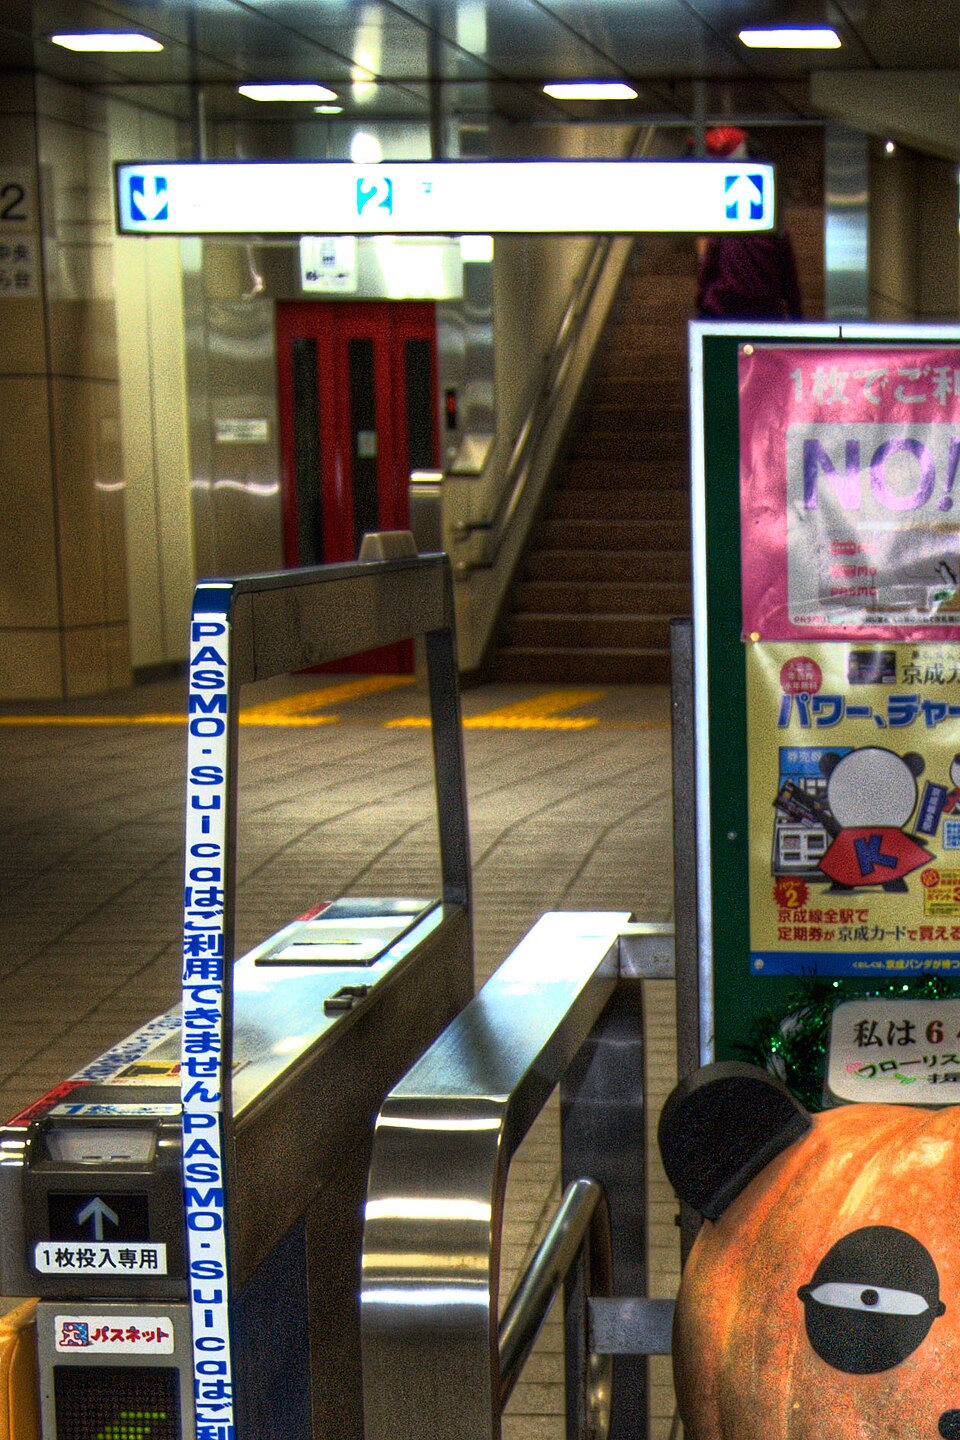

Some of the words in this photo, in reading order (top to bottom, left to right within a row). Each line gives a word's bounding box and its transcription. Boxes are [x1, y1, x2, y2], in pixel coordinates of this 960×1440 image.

[0, 184, 27, 220] 2
[360, 178, 391, 216] 2
[854, 834, 898, 877] K
[786, 889, 799, 908] 2
[777, 909, 869, 924] 京成線全駅で
[43, 1249, 158, 1270] 1枚投入専用
[91, 1325, 170, 1343] パスネット
